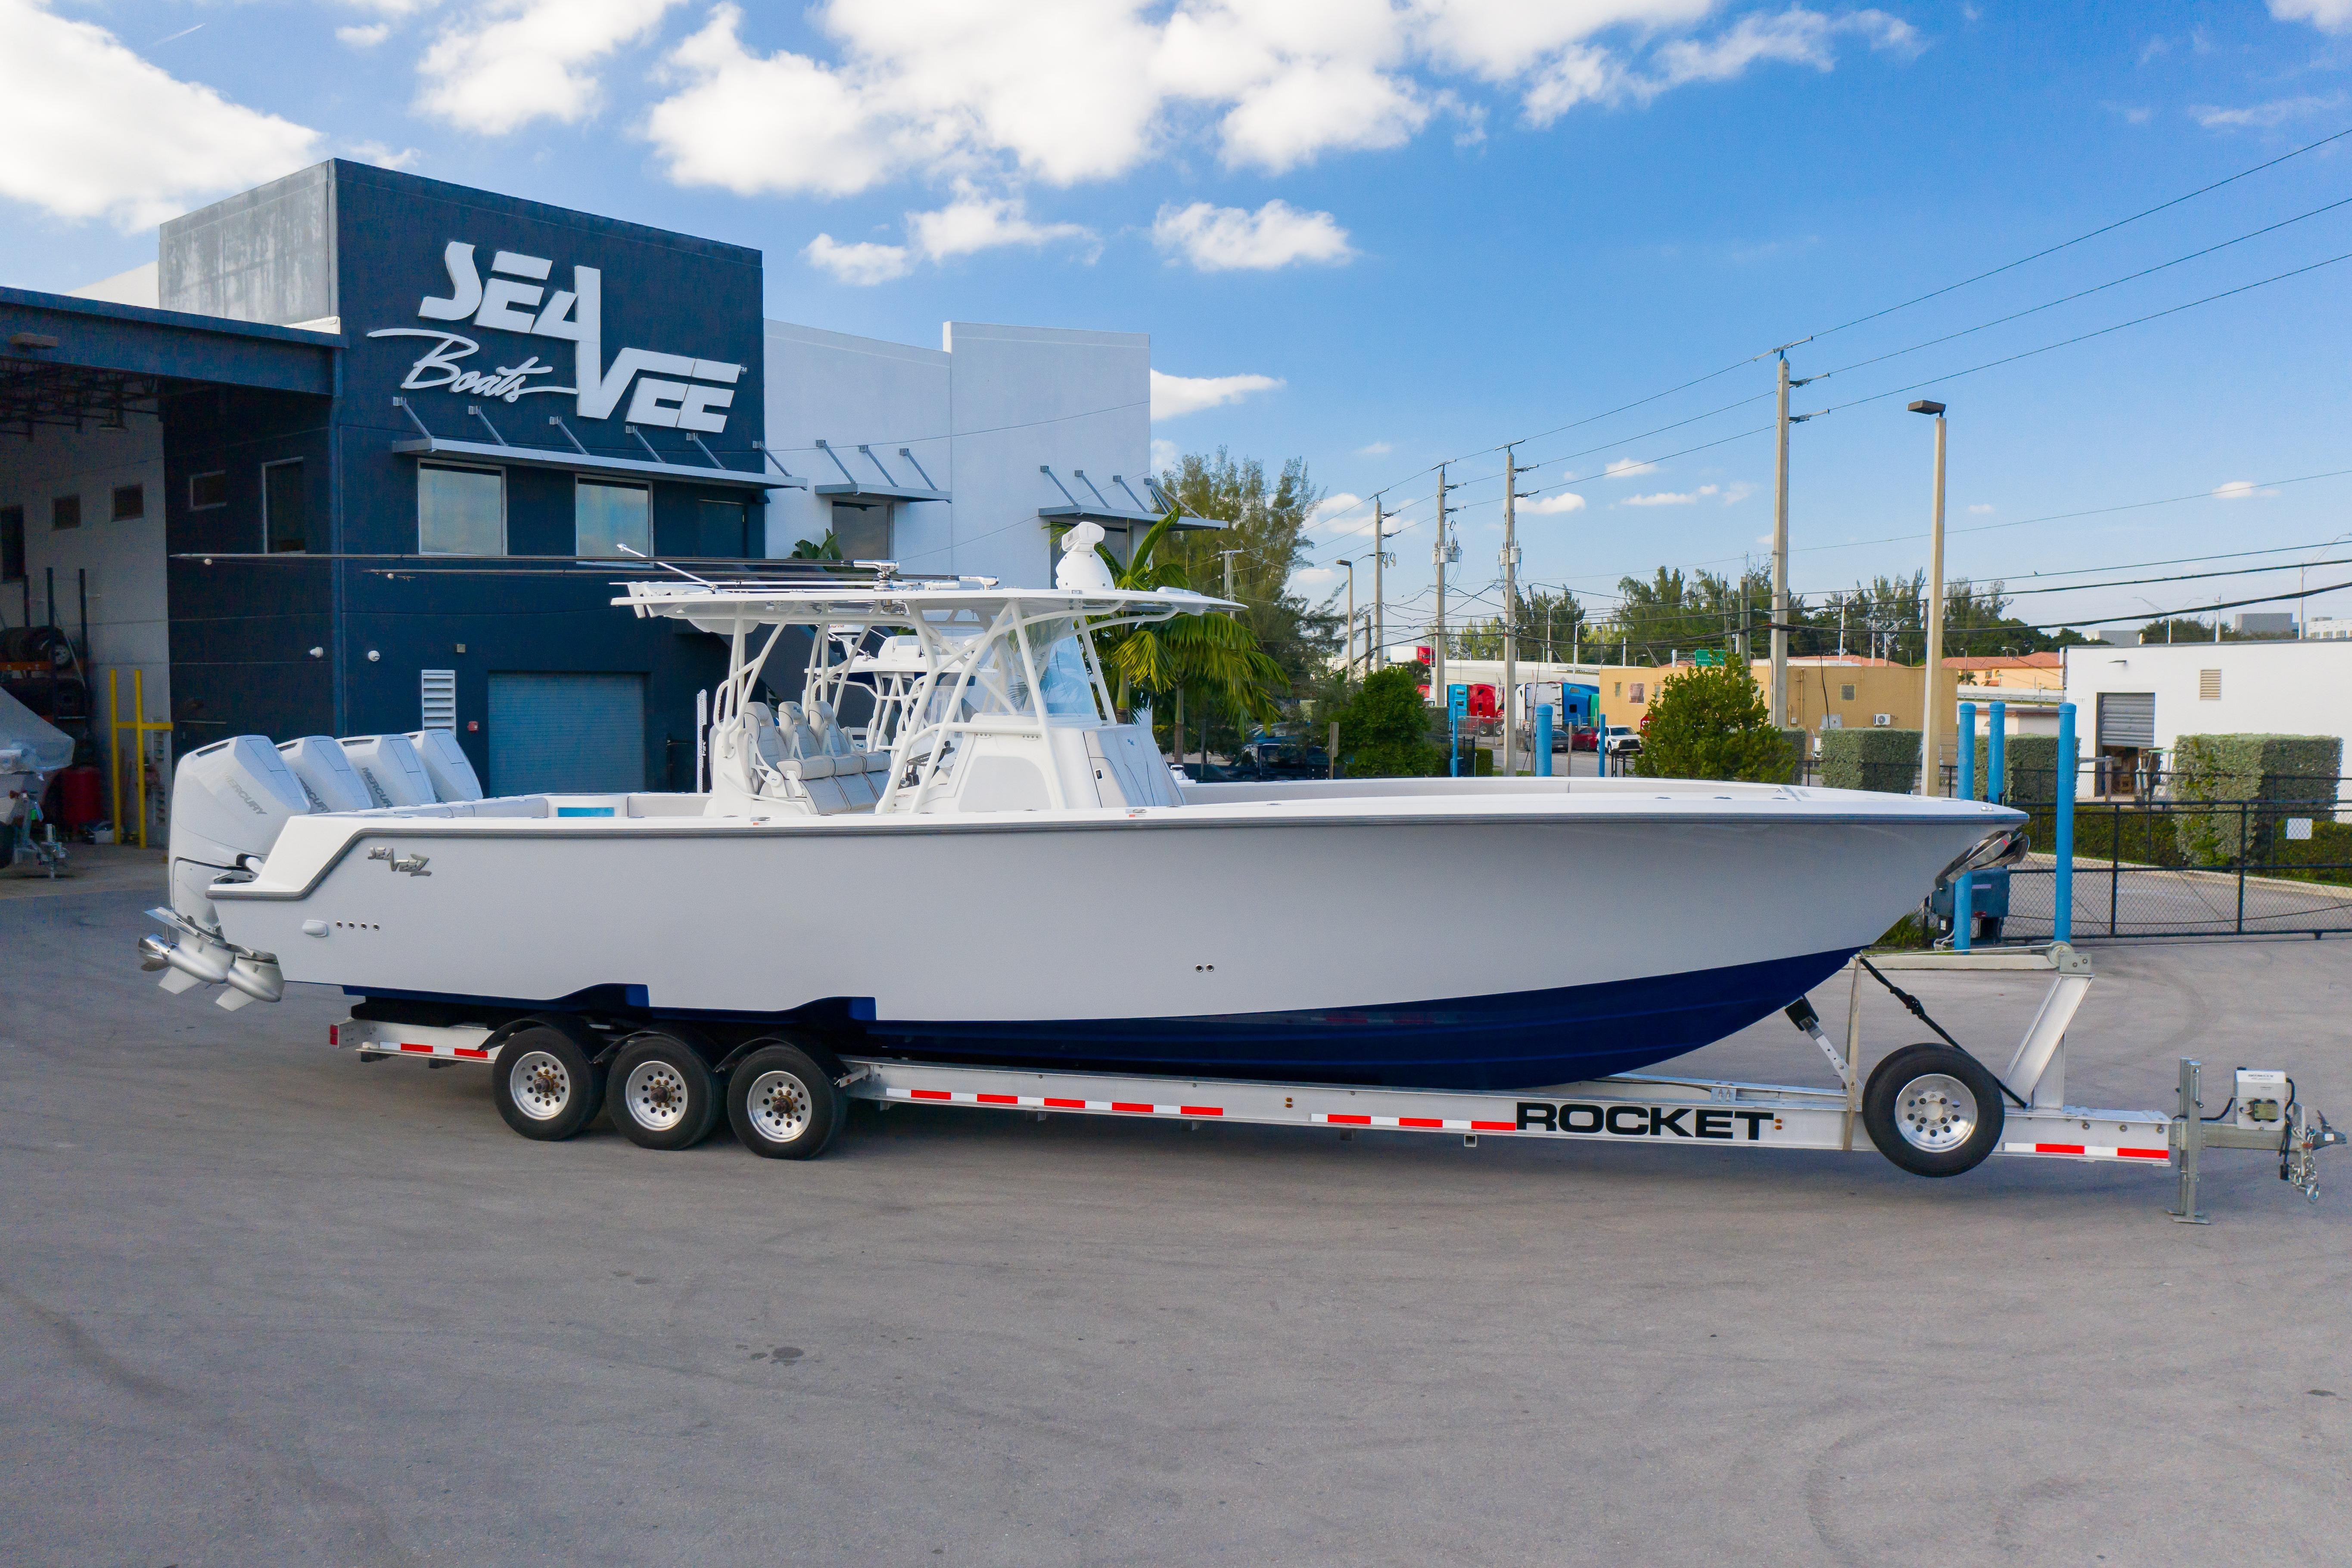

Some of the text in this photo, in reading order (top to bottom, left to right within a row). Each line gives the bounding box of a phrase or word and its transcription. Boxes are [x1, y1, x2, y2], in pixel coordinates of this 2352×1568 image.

[418, 241, 601, 343] SEA
[367, 328, 579, 403] Boats
[576, 342, 741, 433] VEE
[221, 772, 268, 814] MERCURY
[361, 767, 394, 807] MERCUR
[1517, 1102, 1774, 1140] ROCKET
